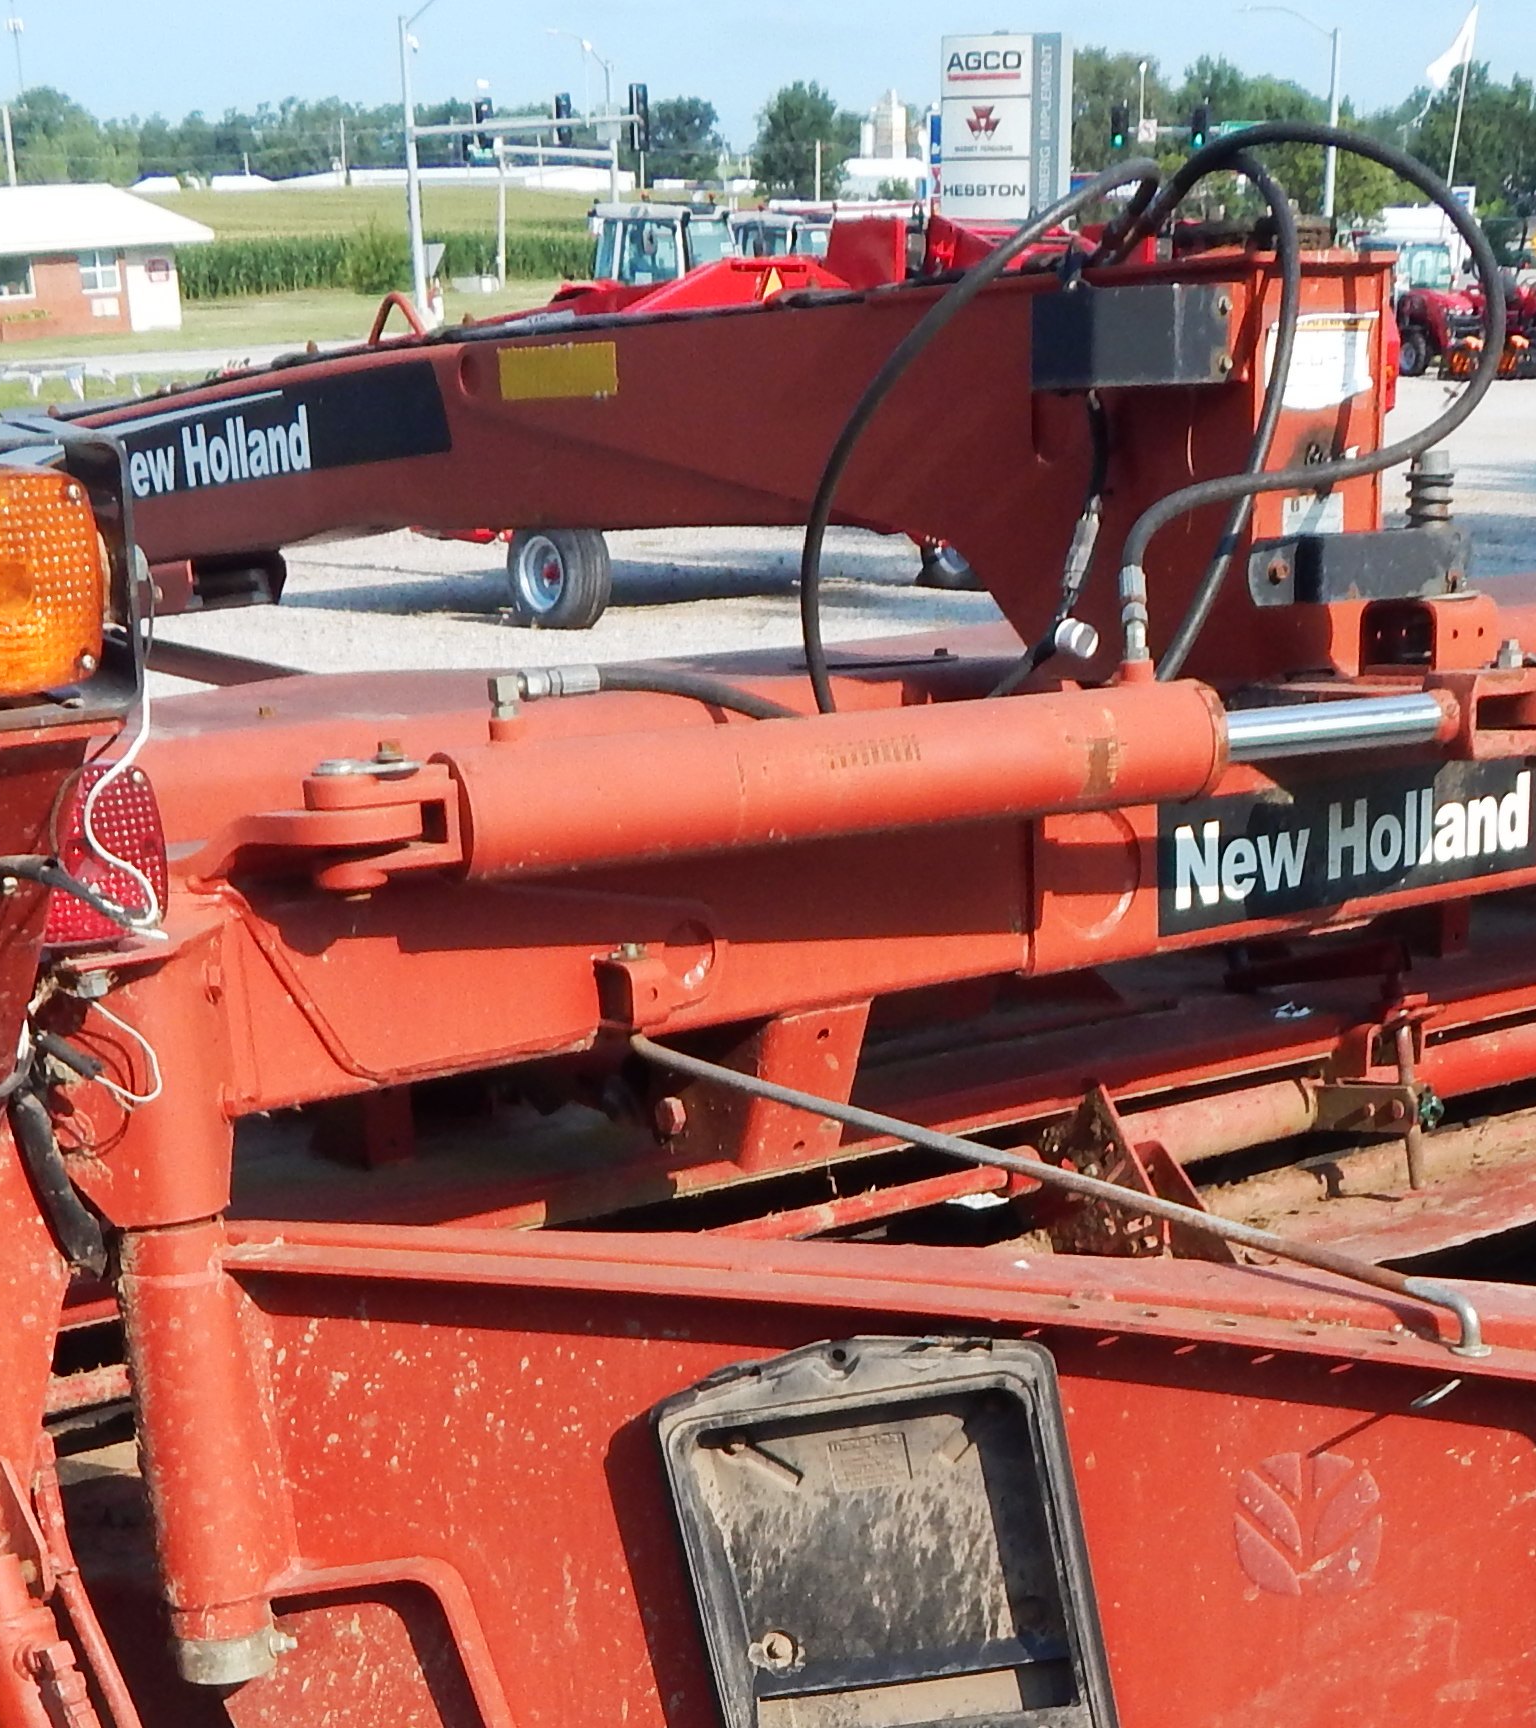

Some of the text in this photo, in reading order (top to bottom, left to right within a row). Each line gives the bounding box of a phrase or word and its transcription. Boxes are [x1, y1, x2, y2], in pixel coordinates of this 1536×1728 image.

[947, 51, 1022, 72] AGCO
[1038, 44, 1053, 211] ENBERG IMPLEMENT
[121, 403, 312, 498] ew Holland
[1174, 769, 1533, 911] New Holland
